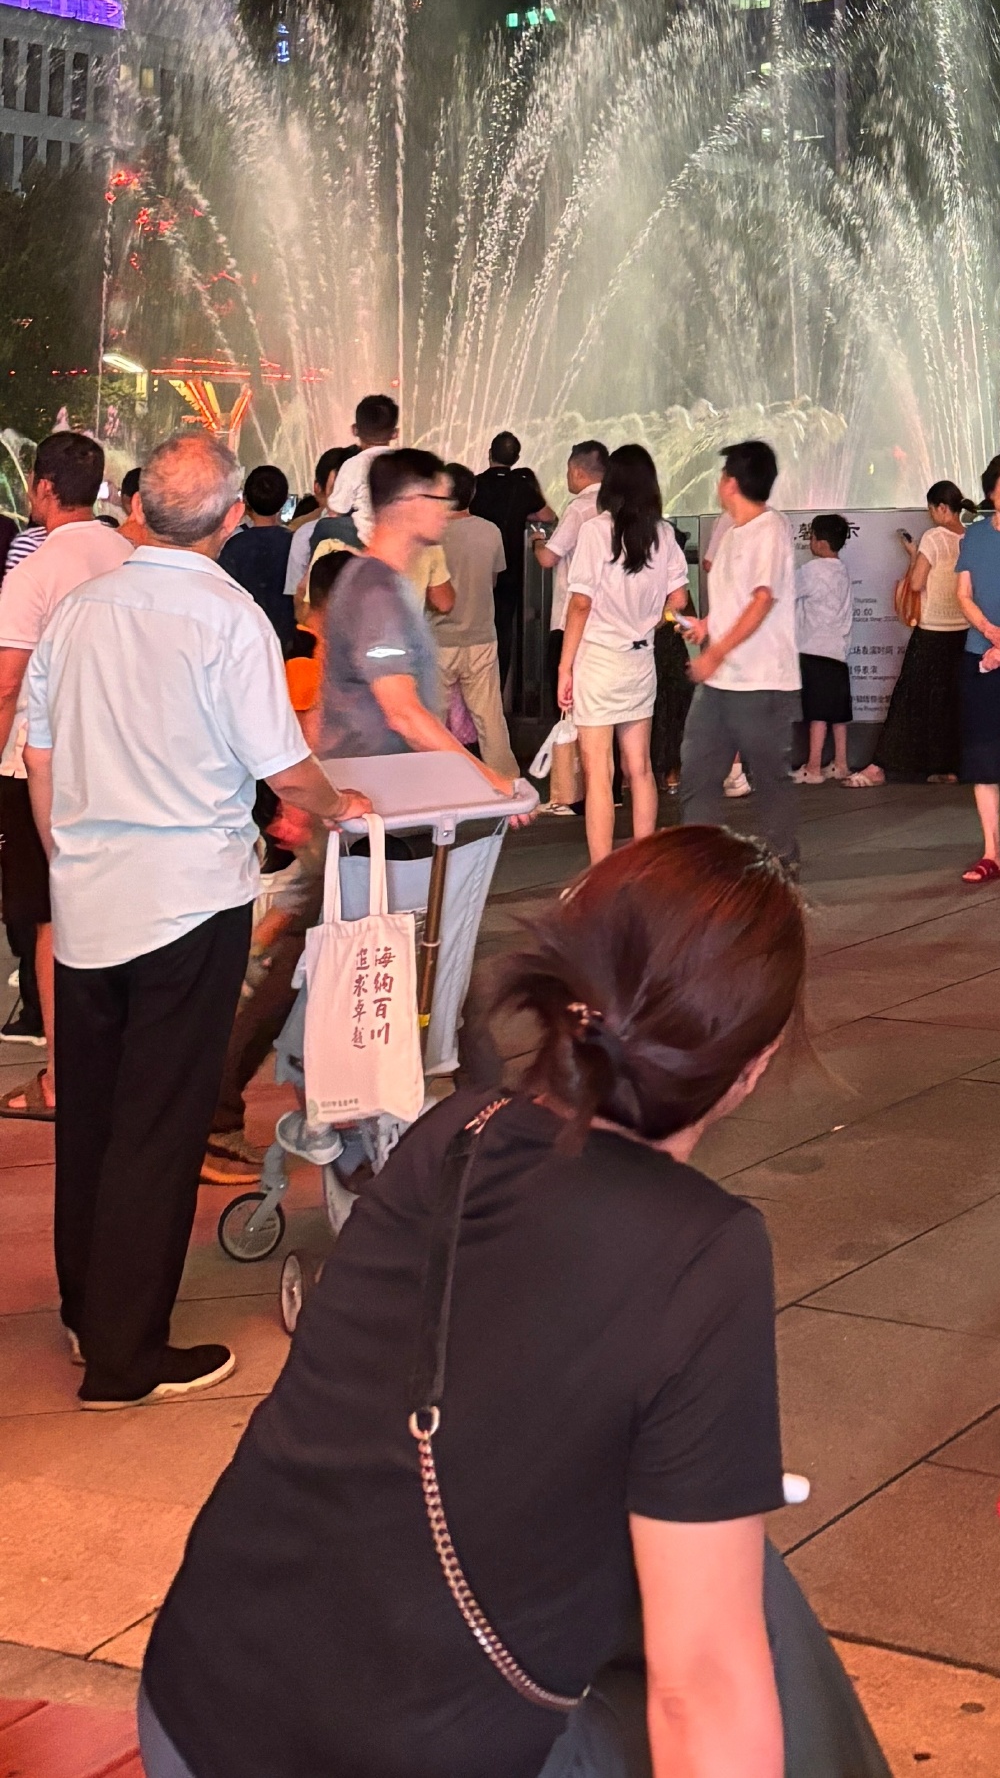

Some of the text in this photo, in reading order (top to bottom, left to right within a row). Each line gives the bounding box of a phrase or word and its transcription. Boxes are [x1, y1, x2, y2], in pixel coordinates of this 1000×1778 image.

[351, 947, 370, 1050] 追求卓越
[370, 946, 396, 1045] 海纳百川
